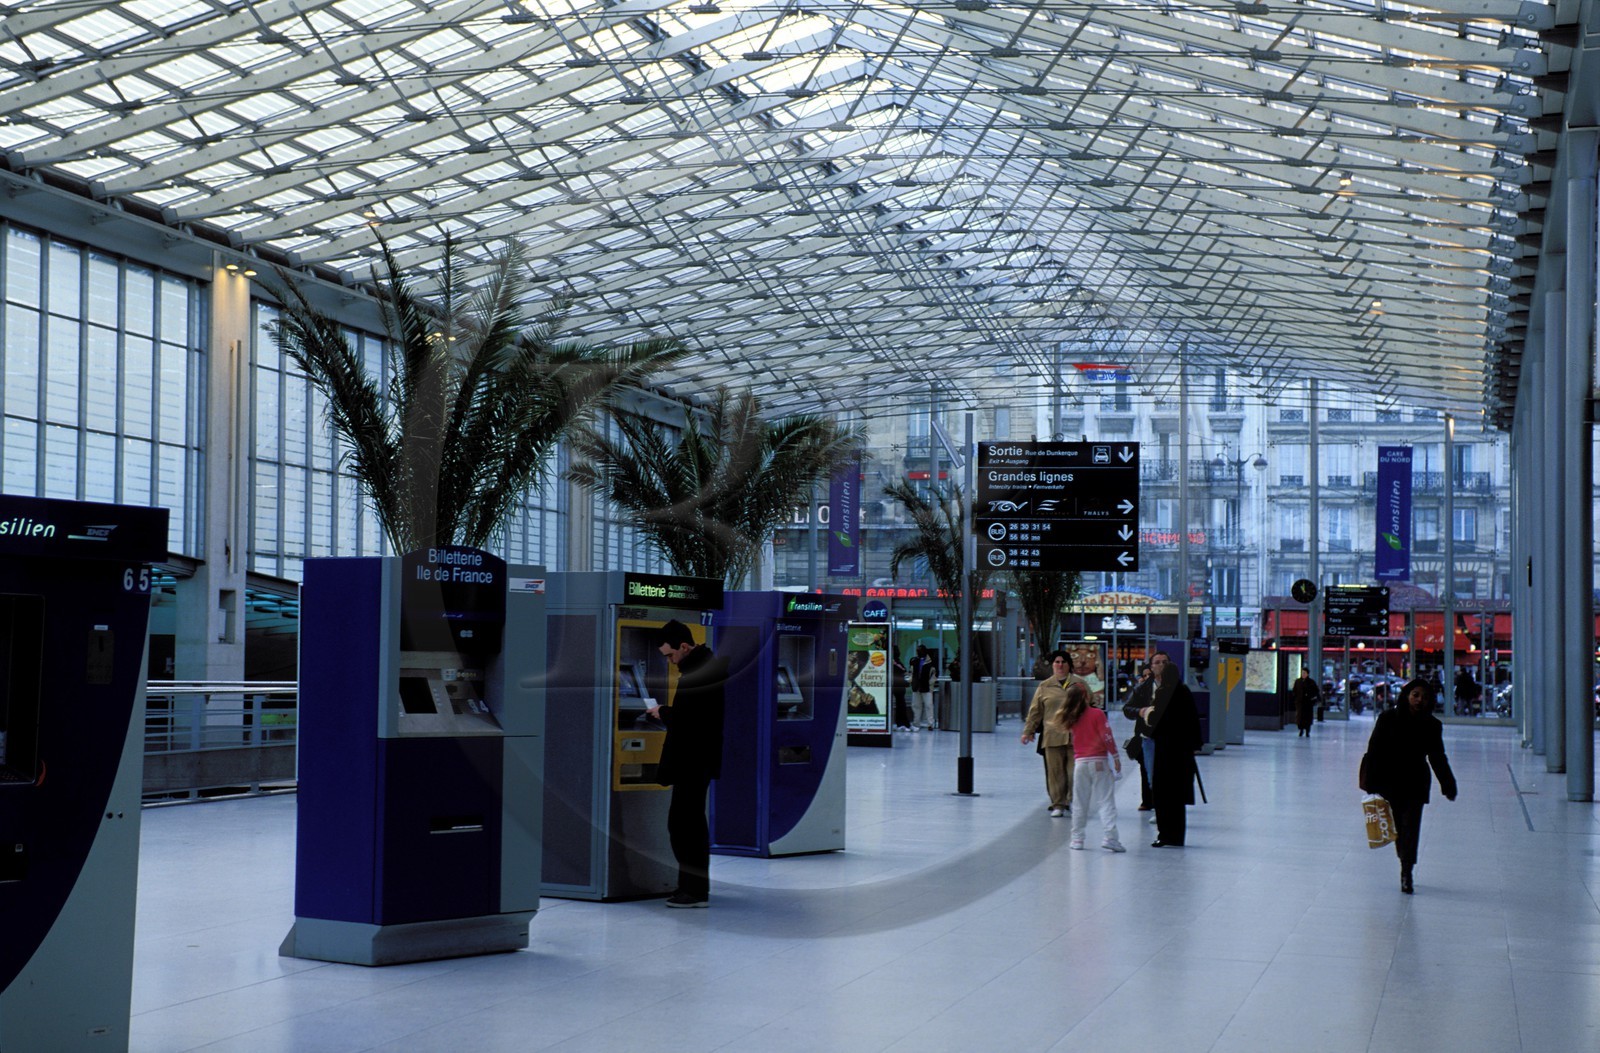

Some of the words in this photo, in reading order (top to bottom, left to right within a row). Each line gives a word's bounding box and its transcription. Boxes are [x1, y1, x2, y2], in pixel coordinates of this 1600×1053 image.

[988, 446, 1023, 456] Sortie
[988, 471, 1037, 482] Grandes
[1039, 471, 1074, 483] lignes
[428, 548, 483, 566] Billetterie
[123, 568, 149, 591] 65
[416, 565, 431, 580] Ile
[434, 567, 449, 581] de
[452, 568, 493, 583] France
[628, 582, 667, 598] Billetterie
[790, 601, 823, 611] Transilien
[701, 612, 713, 626] 77
[863, 608, 887, 618] CAFÉ
[860, 673, 883, 682] Harry
